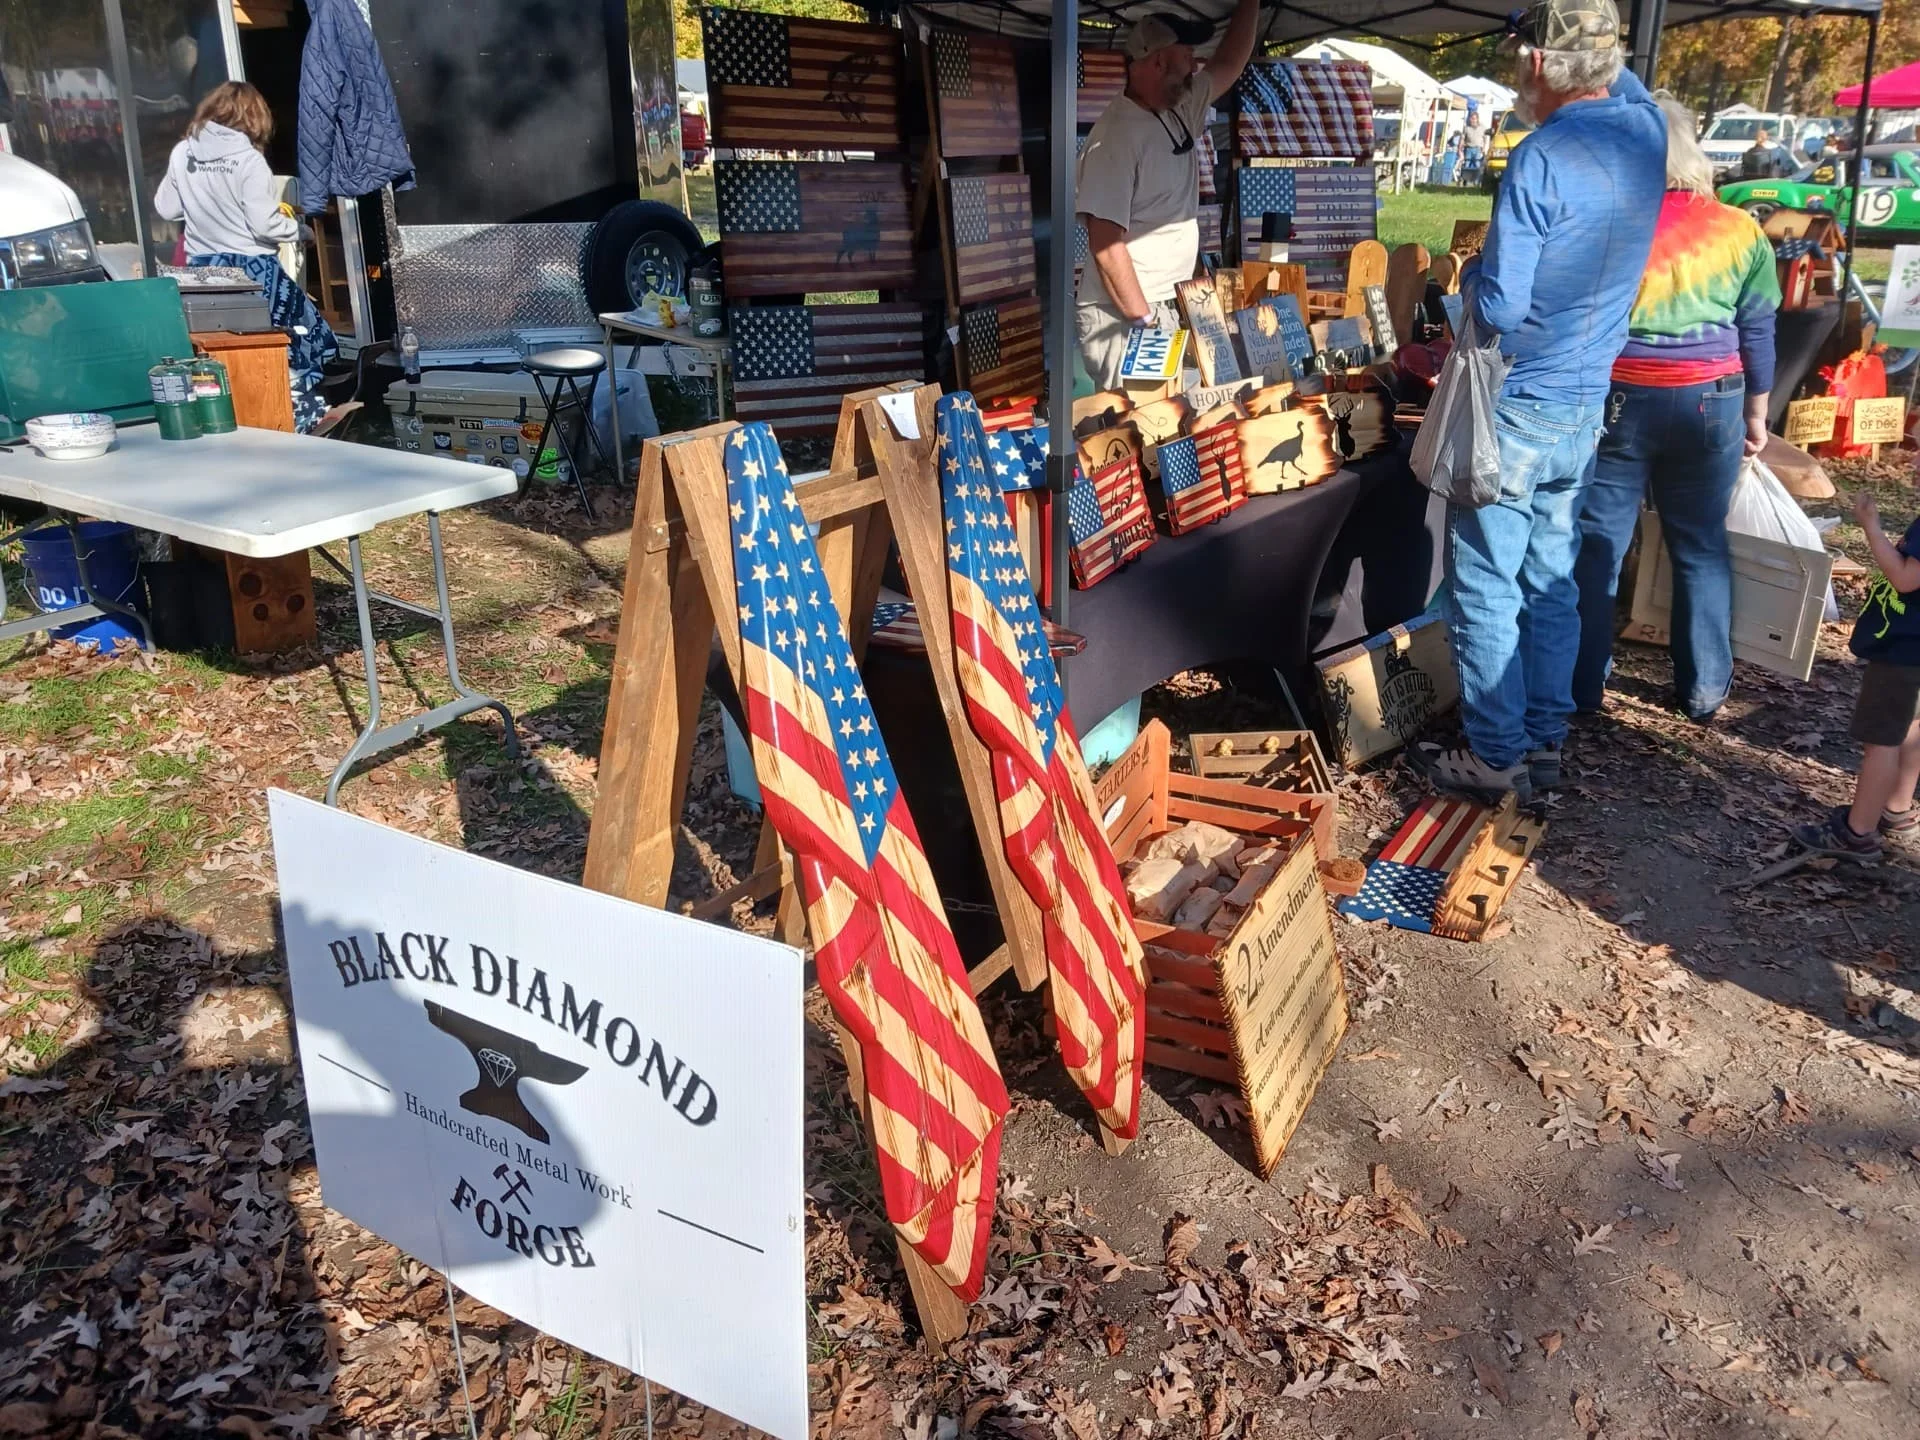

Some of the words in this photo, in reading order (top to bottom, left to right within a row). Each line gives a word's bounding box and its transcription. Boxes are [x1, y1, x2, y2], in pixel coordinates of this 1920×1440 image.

[1860, 190, 1894, 224] 19
[1134, 337, 1170, 373] KWN
[1195, 388, 1233, 408] HOME
[461, 421, 481, 430] YETI
[1860, 420, 1872, 430] OF
[1876, 419, 1897, 430] DOG
[40, 587, 67, 605] DO
[1097, 744, 1141, 809] STARTERS
[1237, 942, 1259, 1009] 2
[1256, 866, 1319, 970] Amendment
[1274, 975, 1295, 1019] regulated
[328, 931, 458, 988] BLACK
[469, 943, 719, 1127] DIAMOND
[1255, 1053, 1278, 1098] necessary
[1290, 1002, 1307, 1036] security
[1271, 1085, 1284, 1114] right
[404, 1091, 509, 1158] Handcrafted
[515, 1142, 570, 1184] Metal
[575, 1167, 633, 1210] Work
[450, 1175, 596, 1268] FORGE
